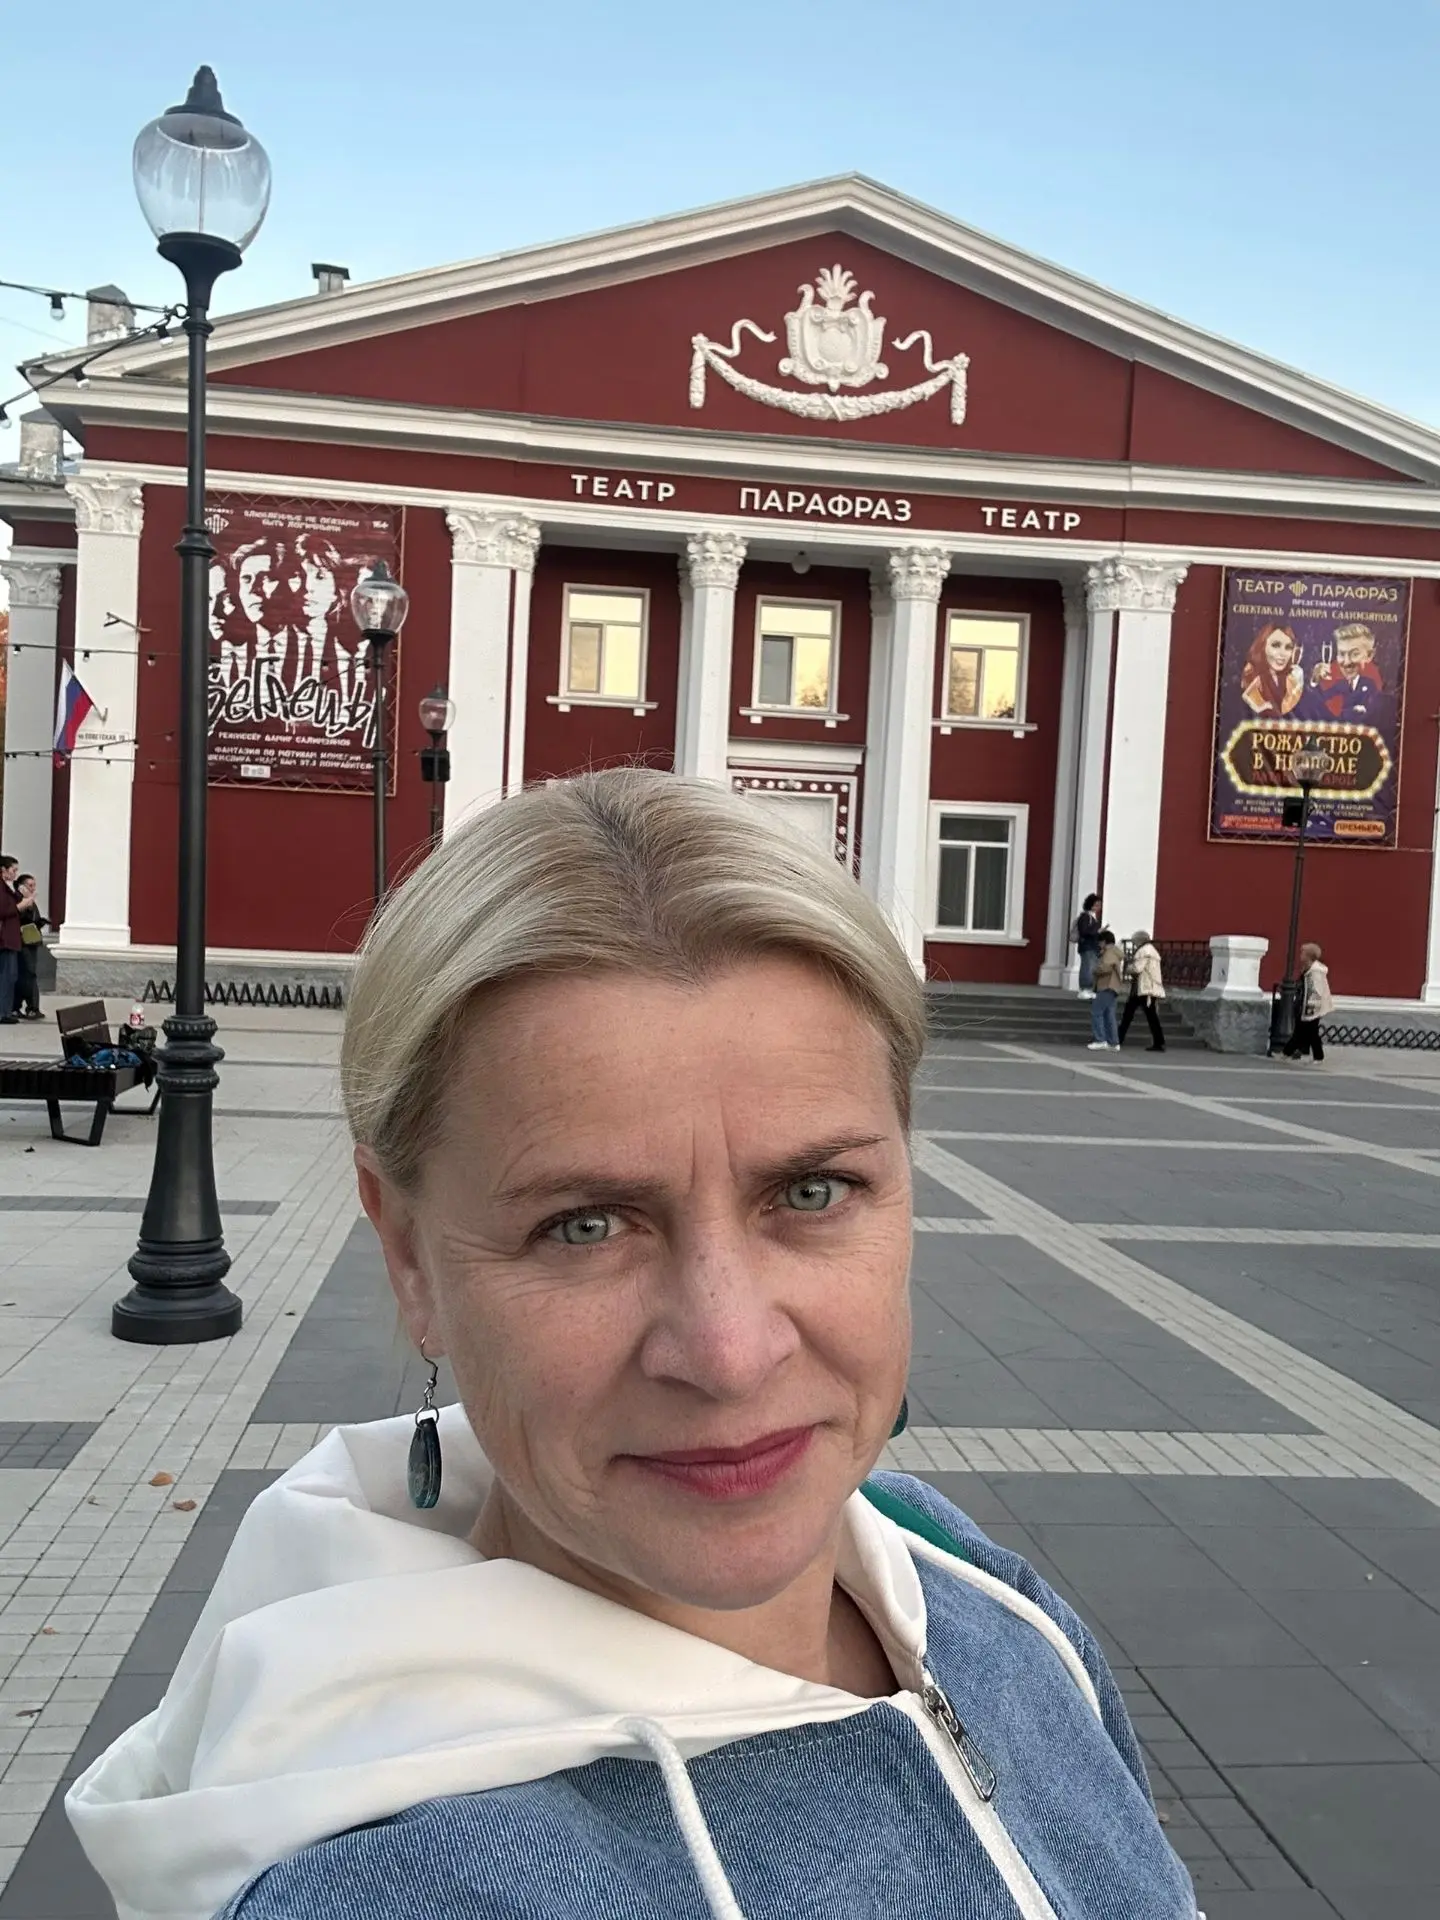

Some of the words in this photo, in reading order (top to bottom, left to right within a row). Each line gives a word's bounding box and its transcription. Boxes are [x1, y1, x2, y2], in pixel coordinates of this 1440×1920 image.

[571, 474, 677, 502] ТЕАТР
[739, 487, 912, 522] ПАРАФРАЗ
[981, 506, 1082, 532] ТЕАТР
[1236, 578, 1285, 594] ТЕАТР
[1312, 583, 1398, 601] ПАРАФРАЗ
[1233, 604, 1284, 616] СПЕКТАКЛЬ
[1289, 607, 1328, 619] ДАМИРА
[1331, 610, 1398, 623] САЛИМЗЯНОВА
[1252, 732, 1362, 755] РОЖДСТВО
[1252, 752, 1264, 770] В
[1335, 822, 1384, 833] ПРЕМЬЕРА
